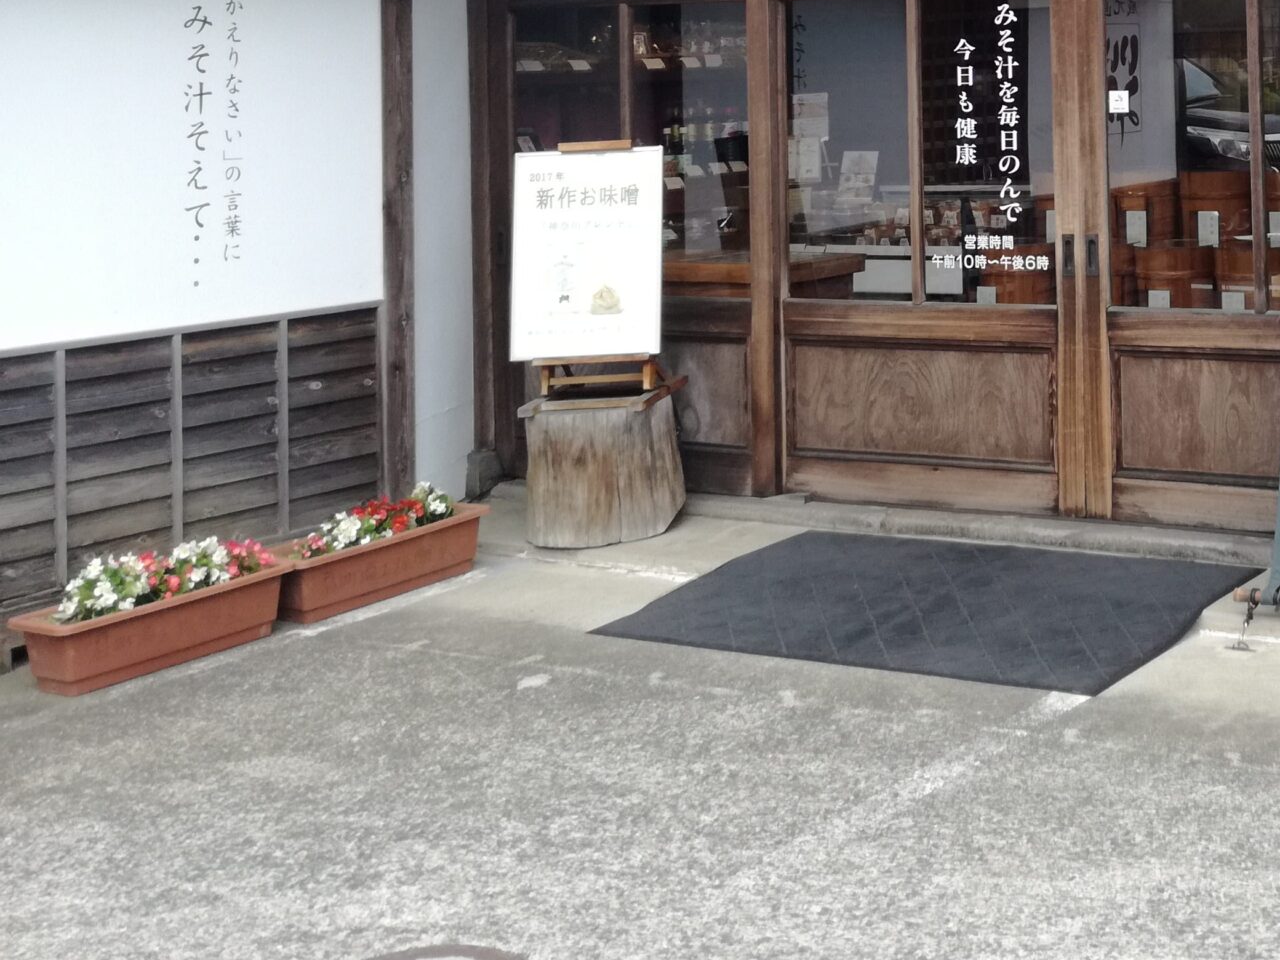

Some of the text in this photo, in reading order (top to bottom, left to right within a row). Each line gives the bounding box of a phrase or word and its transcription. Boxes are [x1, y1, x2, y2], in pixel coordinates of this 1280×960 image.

[953, 38, 978, 166] 今日も健康
[994, 3, 1023, 223] みそ汁を毎日のんで
[536, 183, 640, 210] 新作お味噌
[964, 234, 1014, 250] 営業時間
